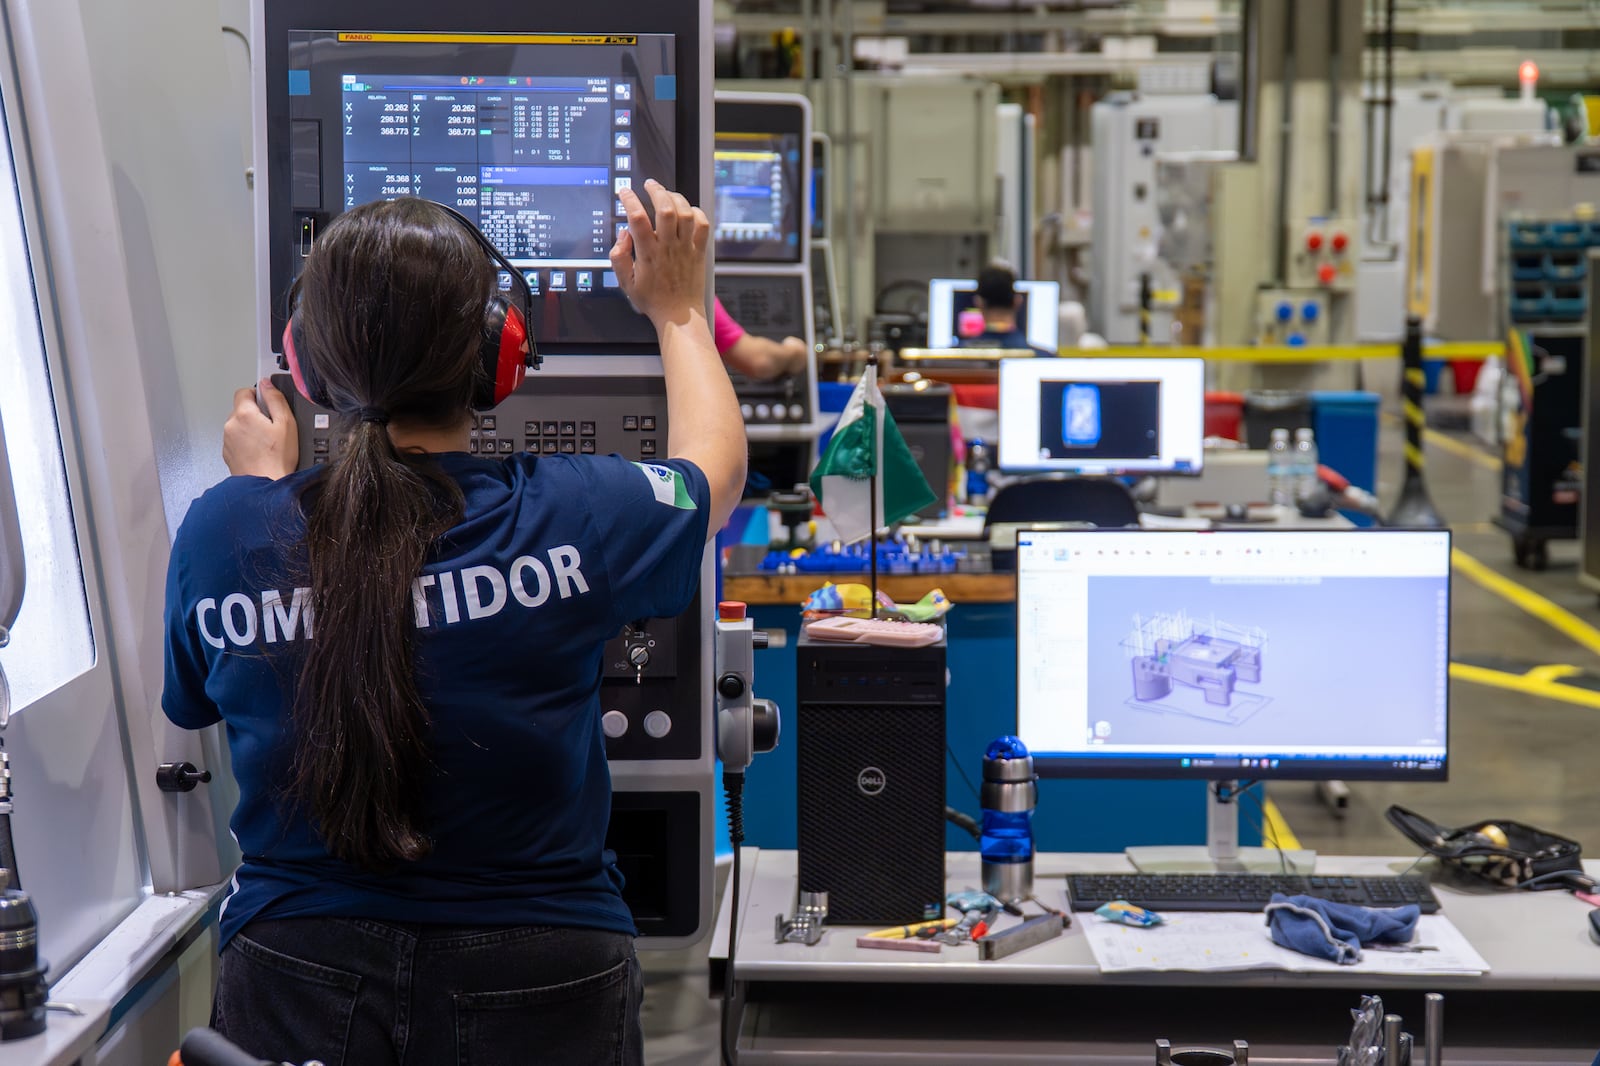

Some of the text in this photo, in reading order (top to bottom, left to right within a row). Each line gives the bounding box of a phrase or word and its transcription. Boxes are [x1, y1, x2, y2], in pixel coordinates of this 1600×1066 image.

[346, 103, 352, 111] X
[413, 104, 420, 112] X
[346, 115, 352, 123] Y
[413, 116, 420, 124] Y
[346, 127, 352, 135] Z
[413, 128, 420, 136] Z
[196, 544, 590, 649] COMTIDOR
